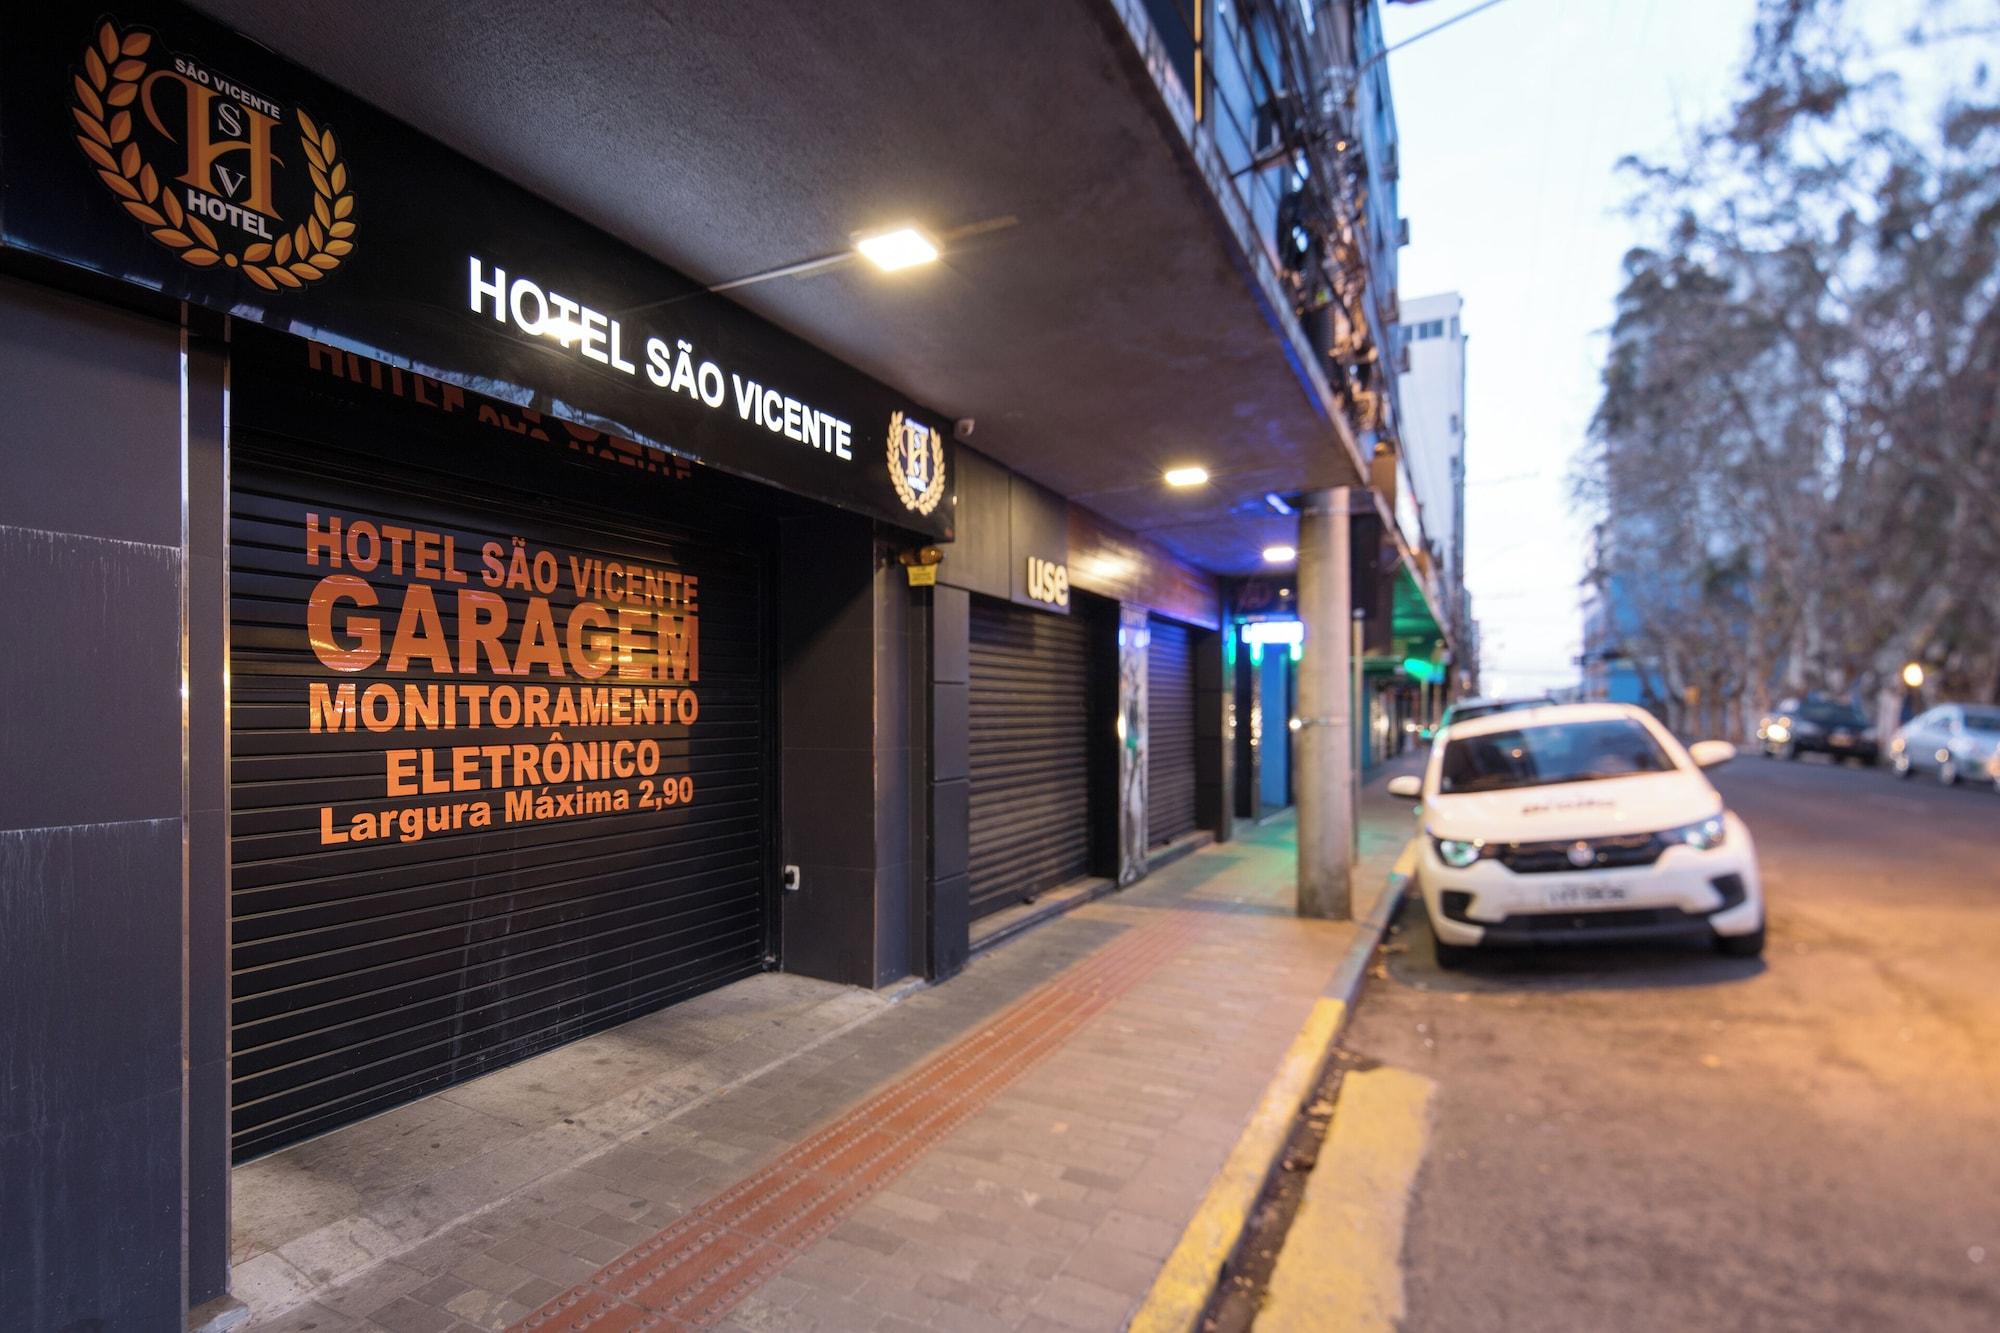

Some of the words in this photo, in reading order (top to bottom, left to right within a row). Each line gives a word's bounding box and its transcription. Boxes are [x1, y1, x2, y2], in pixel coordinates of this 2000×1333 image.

[174, 58, 210, 84] SÃO
[213, 75, 281, 119] VICENTE
[187, 188, 273, 240] HOTEL
[469, 256, 636, 376] HOTEL
[646, 338, 725, 408] SÃO
[731, 372, 853, 461] VICENTE
[305, 512, 468, 584] HOTEL
[480, 536, 559, 595] SÃO
[568, 555, 699, 611] VICENTE
[1027, 556, 1069, 606] use
[306, 574, 700, 683] GARAGEM
[308, 682, 699, 734] MONITORAMENTO
[385, 731, 661, 798] ELETRÔNICO
[319, 799, 492, 846] Largura
[504, 782, 630, 823] Máxima
[637, 775, 694, 812] 2,90
